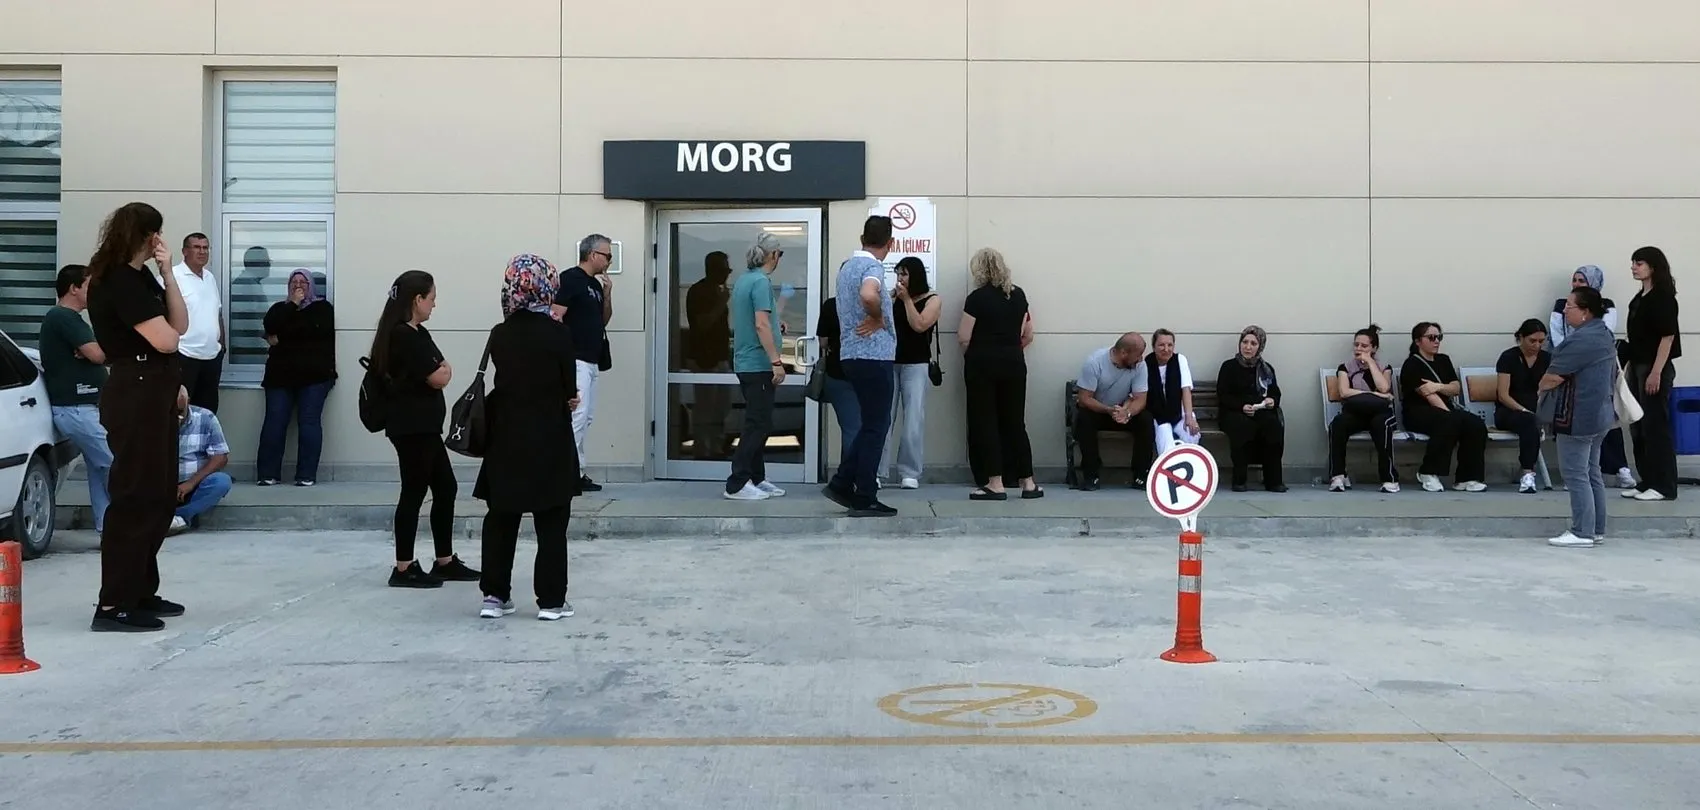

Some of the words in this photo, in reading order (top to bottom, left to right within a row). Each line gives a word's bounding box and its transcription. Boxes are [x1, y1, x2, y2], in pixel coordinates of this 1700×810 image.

[676, 142, 792, 173] MORG
[902, 237, 931, 254] İÇİLMEZ
[1166, 461, 1194, 505] P
